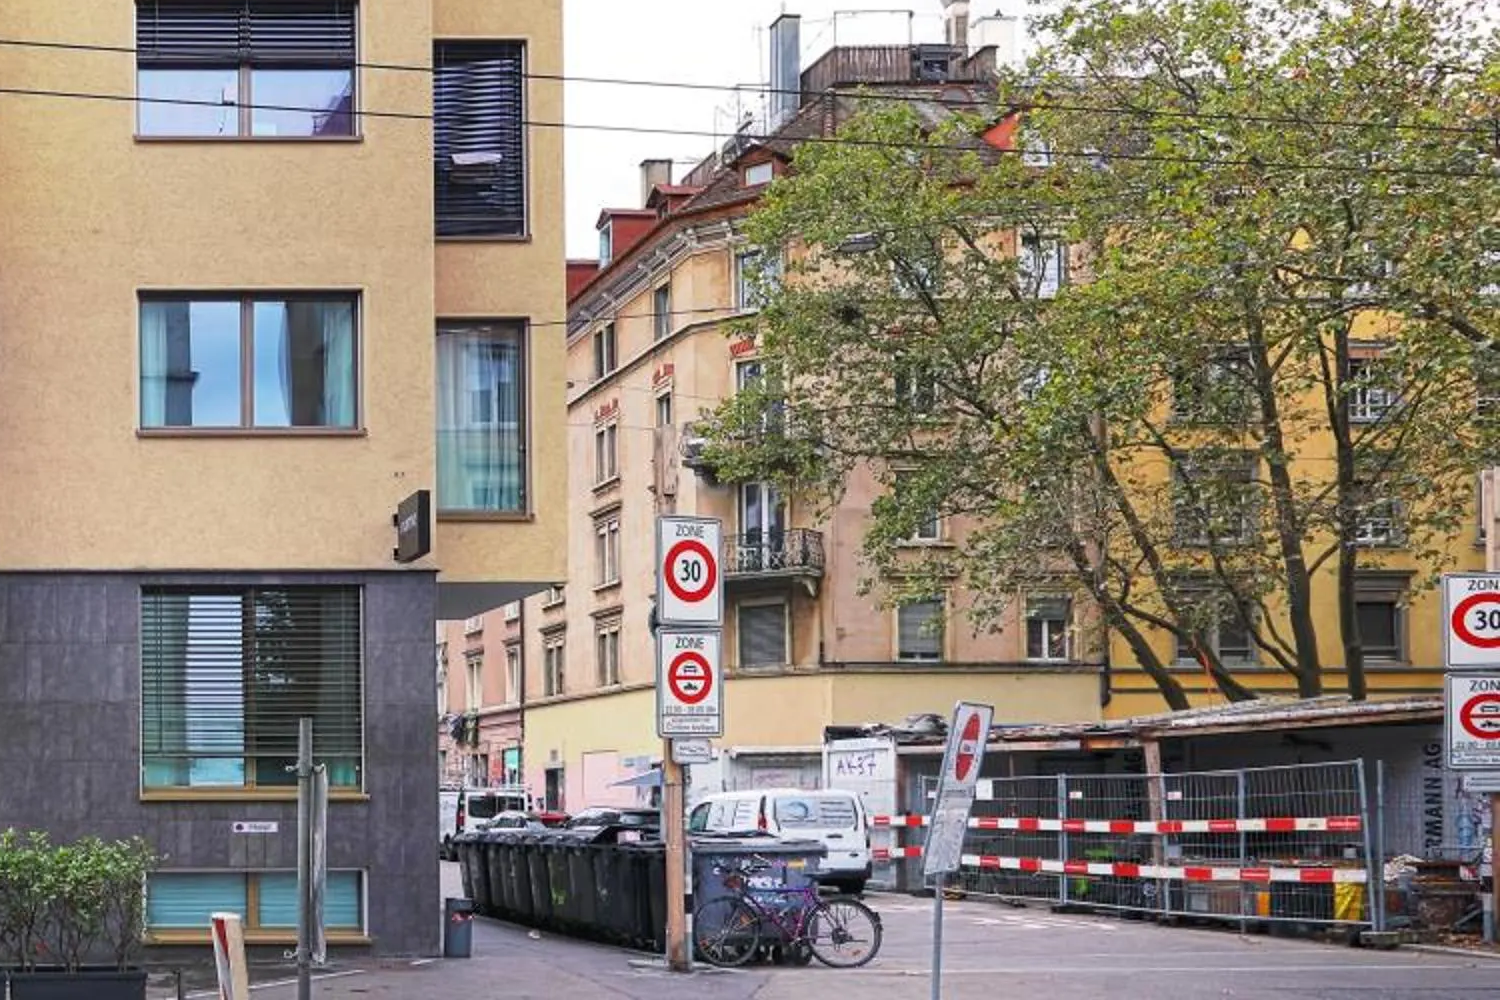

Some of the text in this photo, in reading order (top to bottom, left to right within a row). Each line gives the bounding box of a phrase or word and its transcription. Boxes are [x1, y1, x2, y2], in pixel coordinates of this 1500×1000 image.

[675, 523, 704, 538] ZONE
[680, 559, 701, 582] 30
[1473, 609, 1500, 631] 30
[675, 635, 705, 649] ZONE
[1424, 743, 1442, 769] AG
